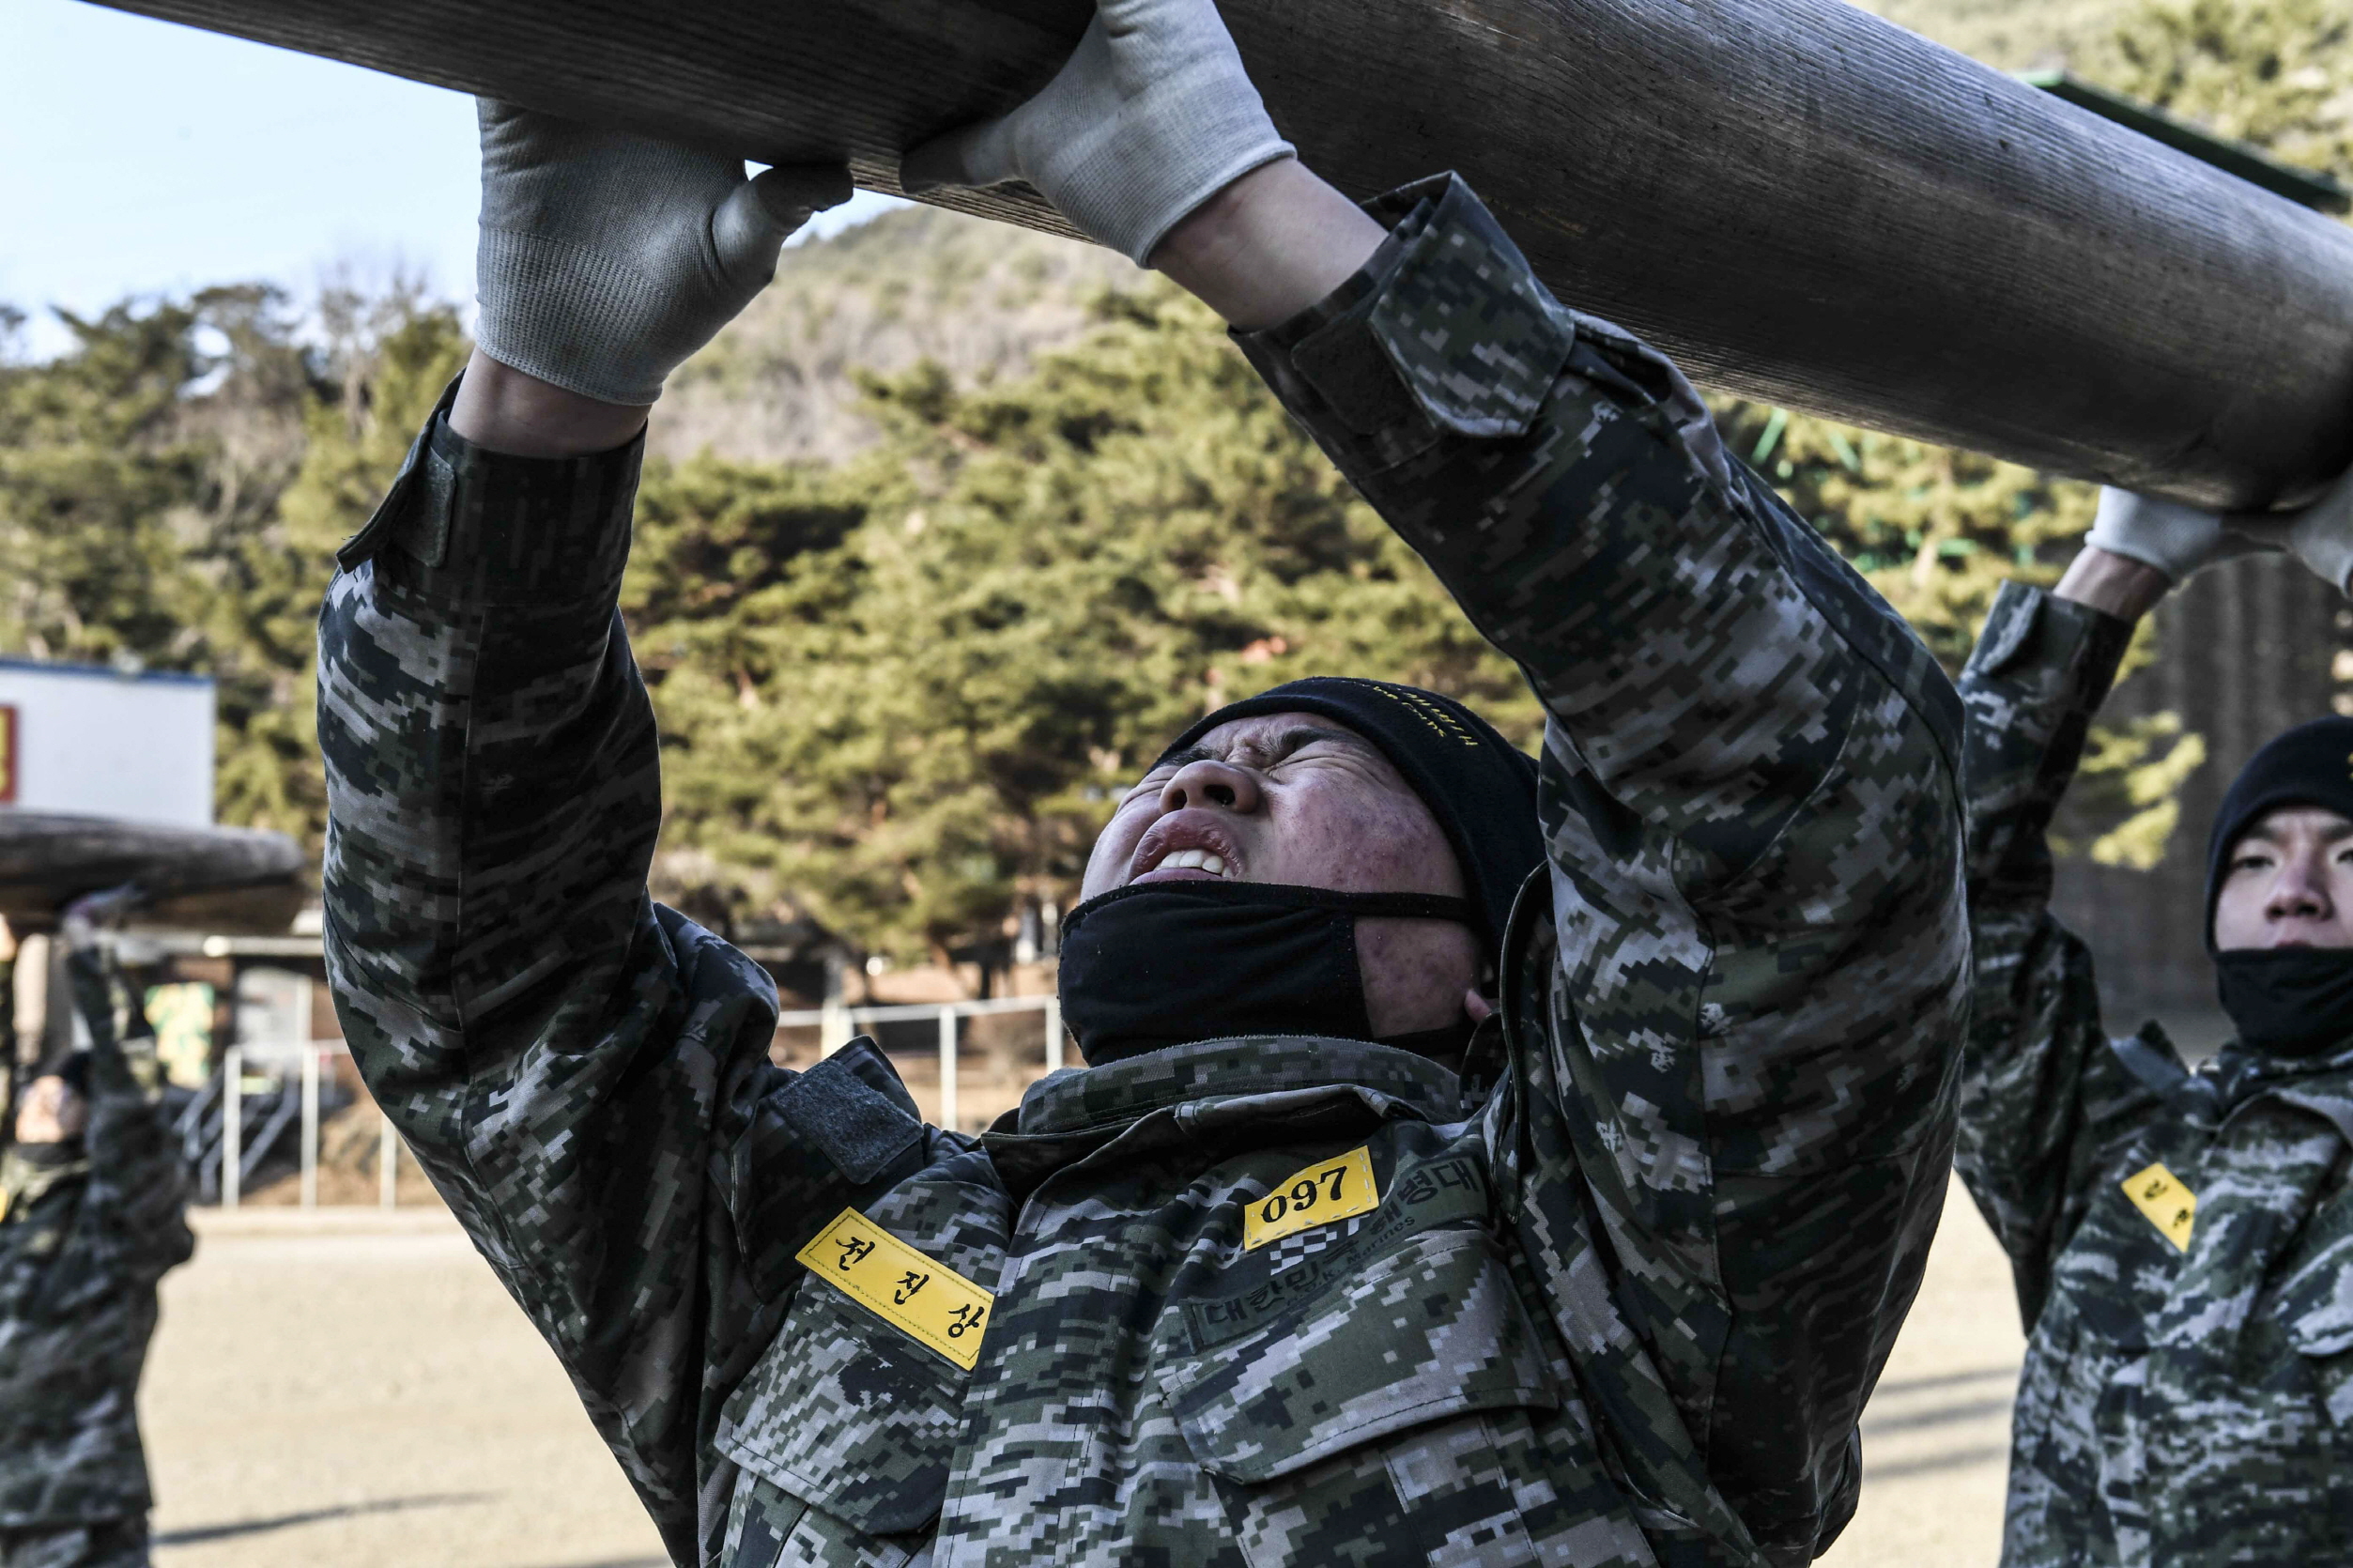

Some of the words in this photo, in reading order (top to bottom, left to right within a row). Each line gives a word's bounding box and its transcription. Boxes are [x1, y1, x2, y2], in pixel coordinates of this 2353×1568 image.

[1261, 1165, 1348, 1223] 097
[1368, 1160, 1480, 1236] 해병대
[1347, 1216, 1416, 1264] Marines
